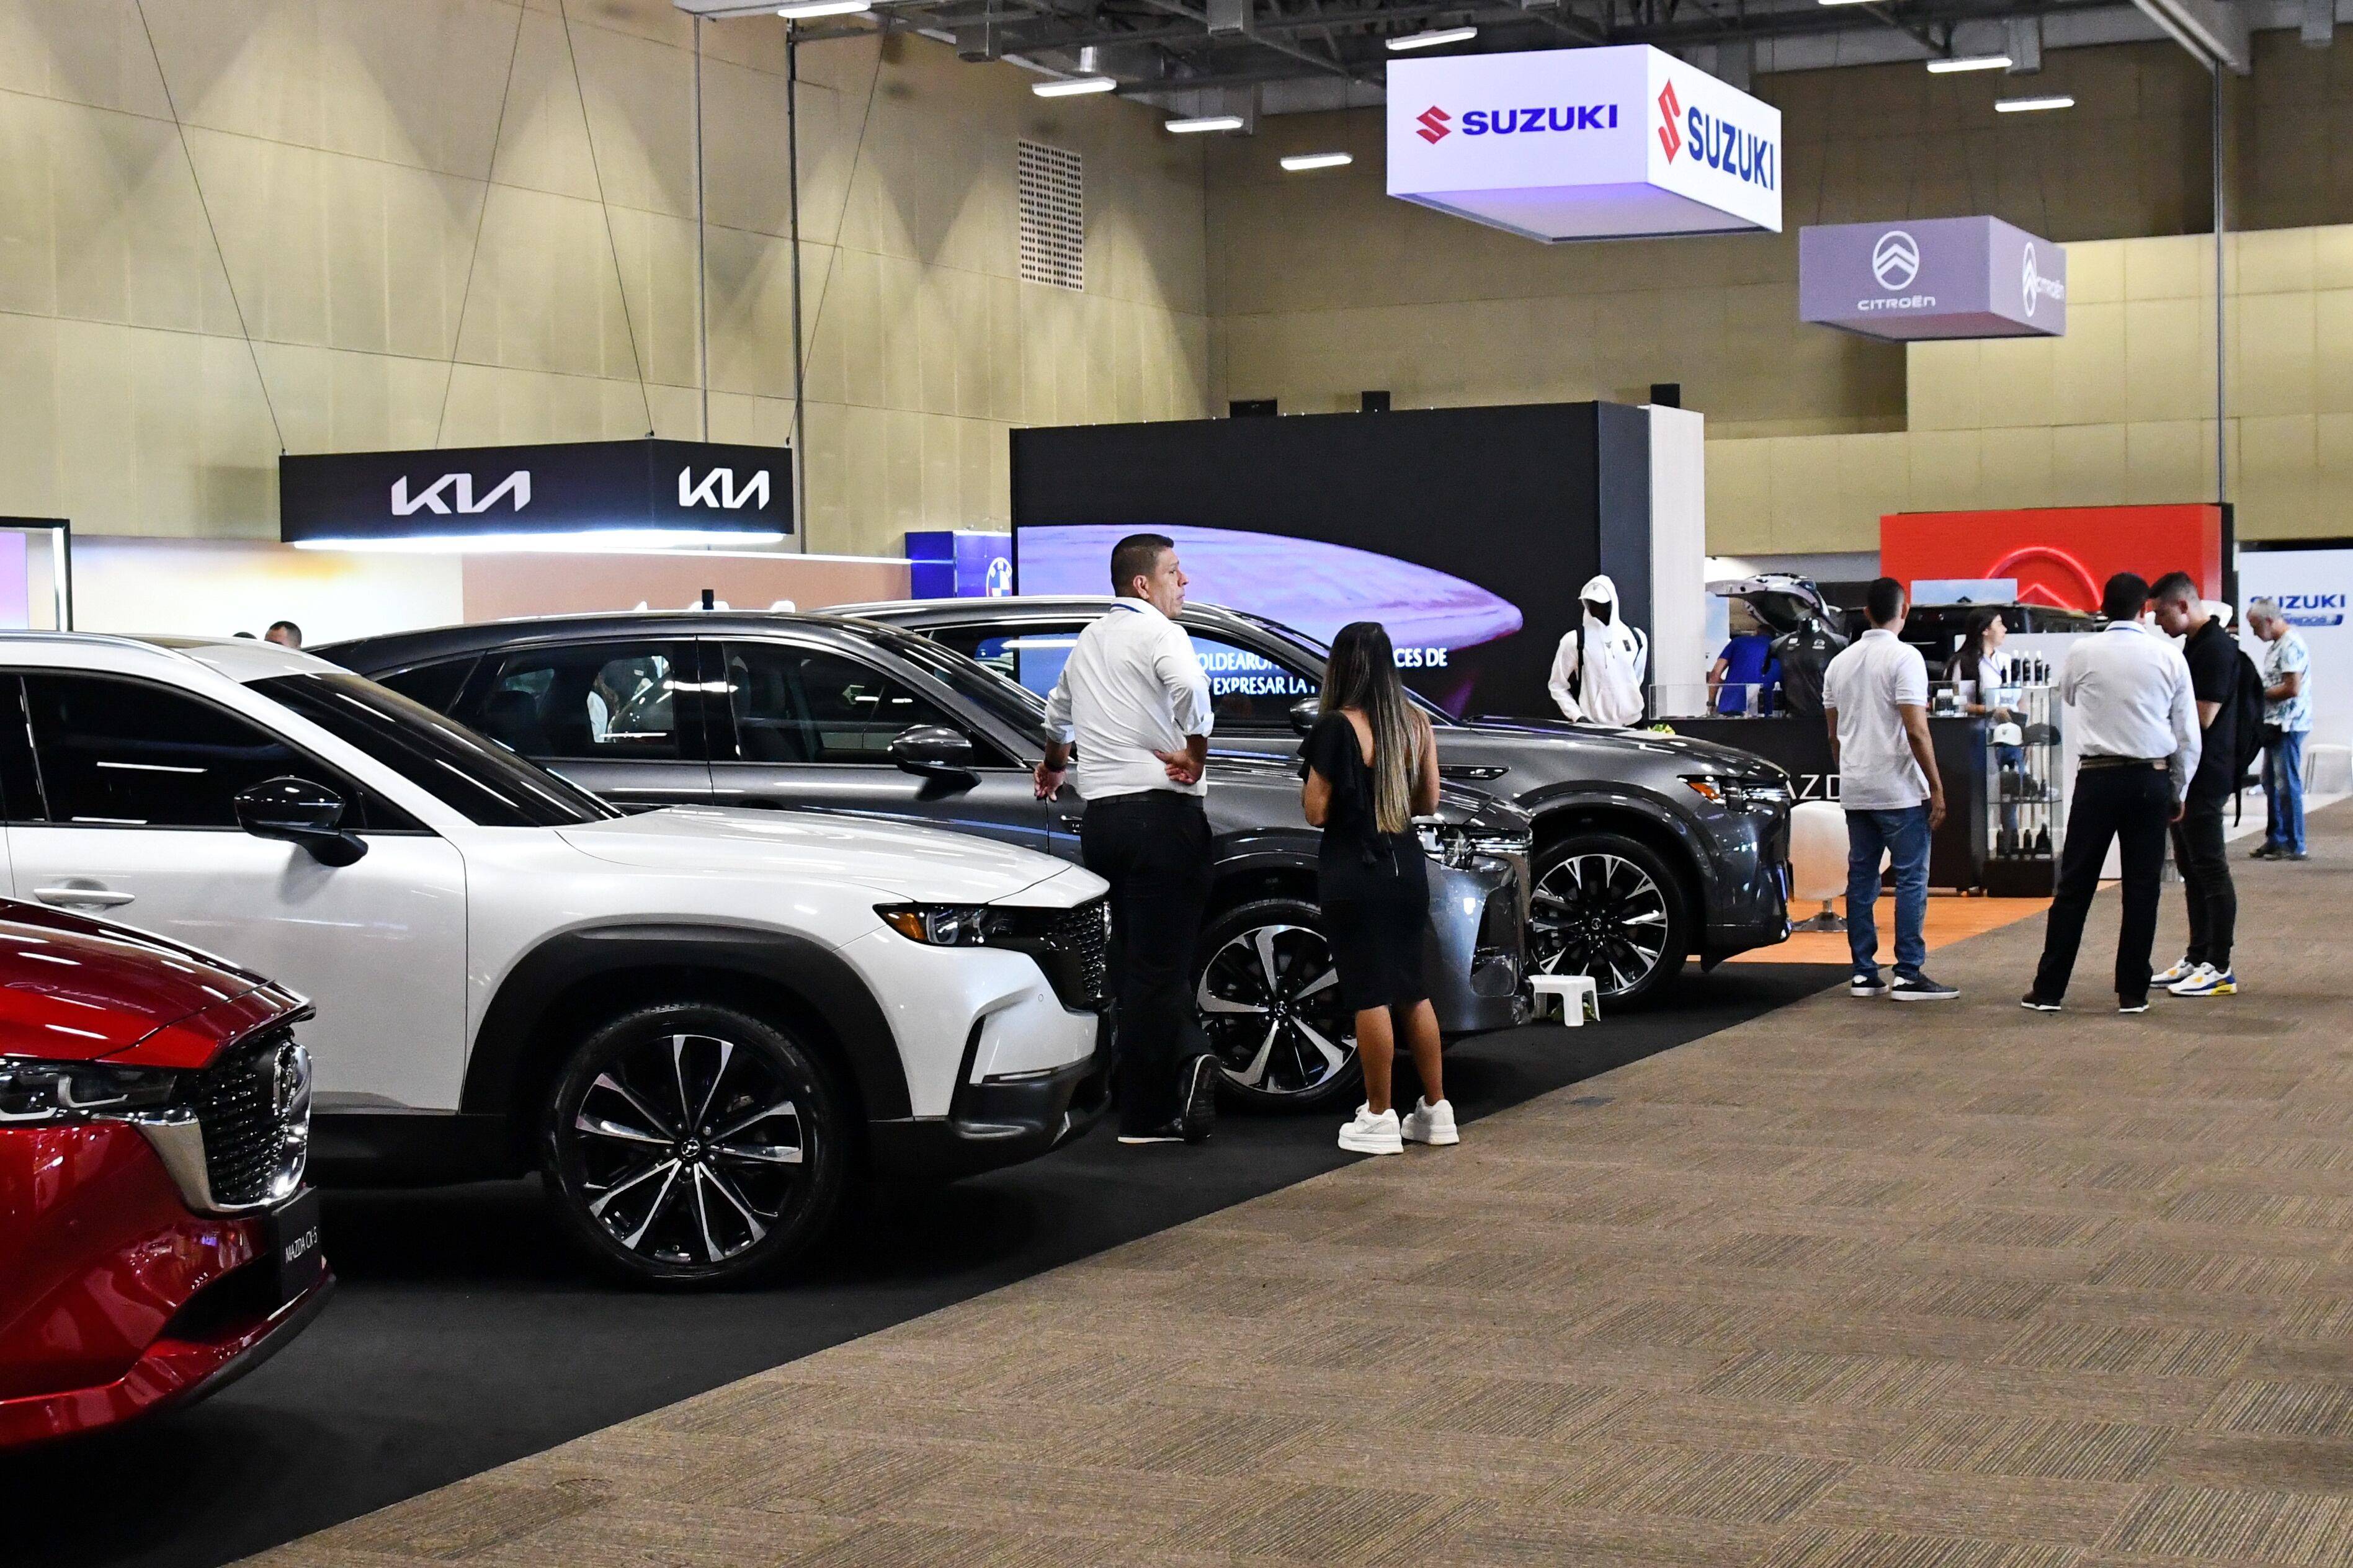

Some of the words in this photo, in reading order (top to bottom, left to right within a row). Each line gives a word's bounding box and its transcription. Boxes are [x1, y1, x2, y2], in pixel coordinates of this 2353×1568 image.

[1462, 104, 1619, 136] SUZUKI
[1687, 105, 1775, 191] SUZUKI
[391, 470, 532, 516] KIA
[679, 466, 770, 510] KIA
[1197, 653, 1280, 670] OLDEARO
[1393, 648, 1423, 668] CES
[1426, 648, 1448, 667] DE
[1213, 676, 1286, 695] EXPRESAR
[1289, 676, 1308, 694] LA
[1786, 774, 1841, 800] AZD
